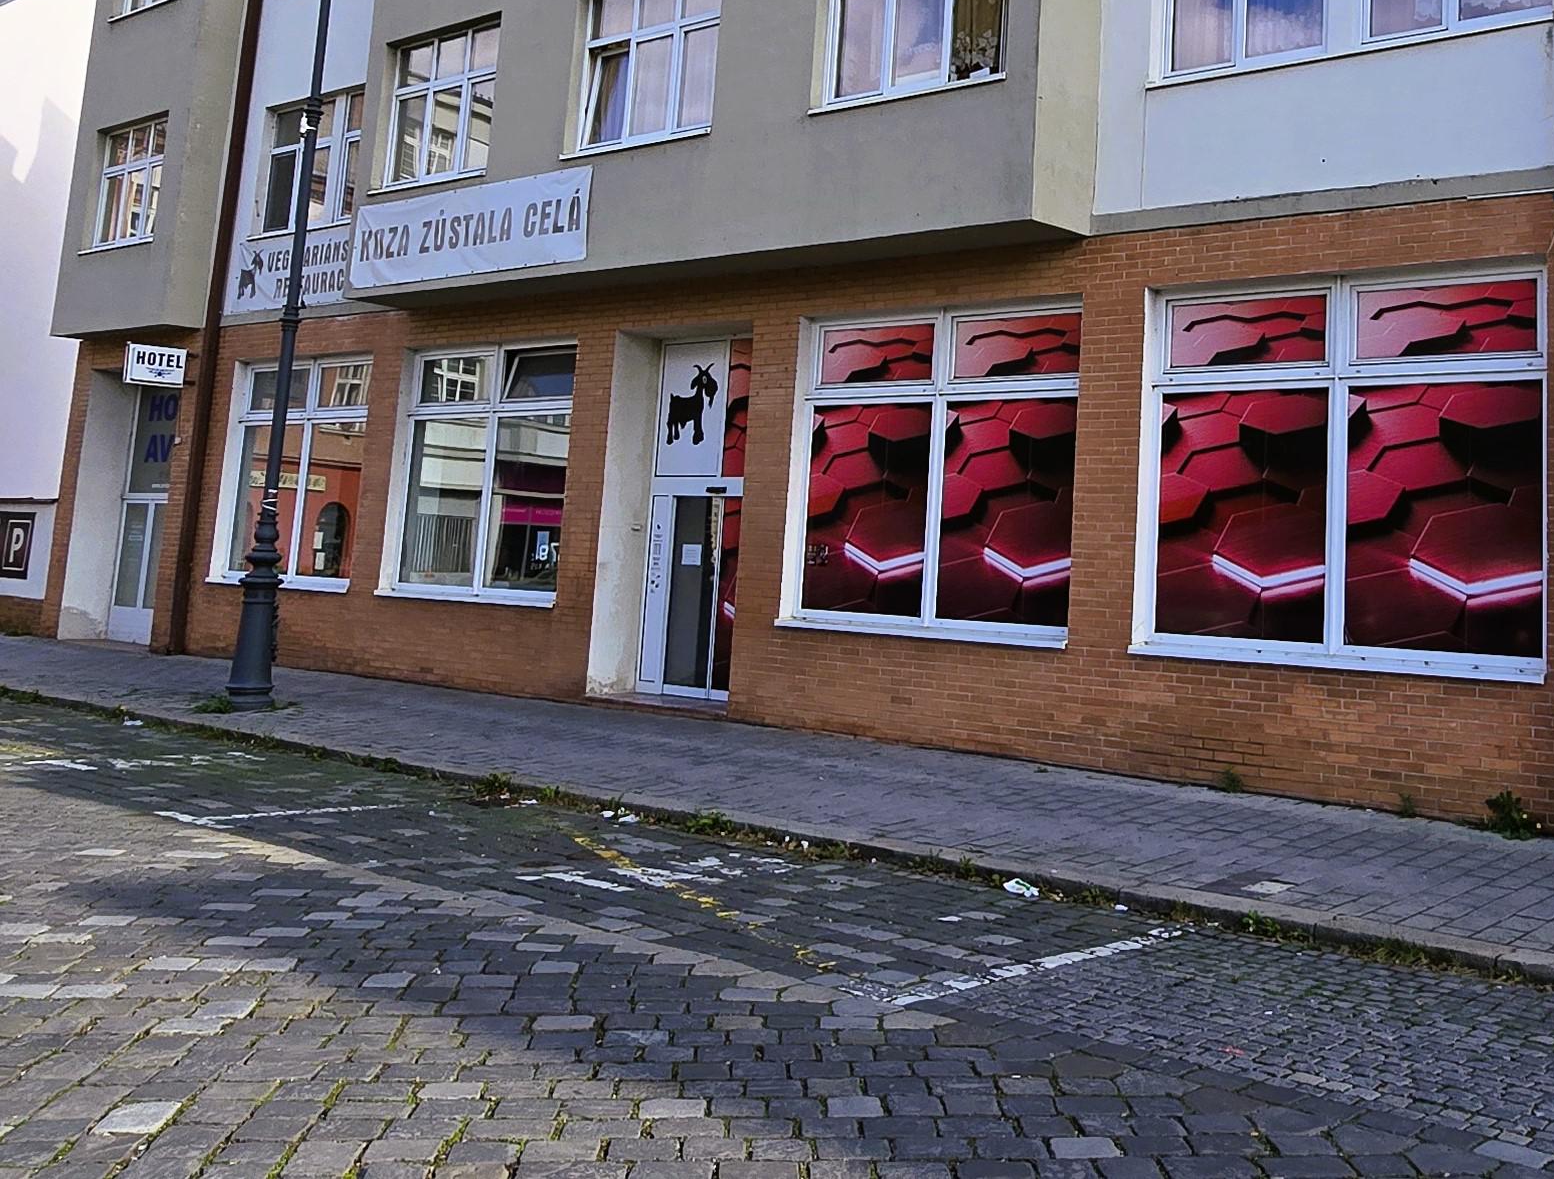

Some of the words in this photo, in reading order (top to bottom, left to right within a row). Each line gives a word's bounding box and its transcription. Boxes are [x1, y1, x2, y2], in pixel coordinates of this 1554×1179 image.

[359, 224, 411, 263] KOZA
[523, 188, 582, 239] CELÁ
[267, 238, 350, 273] VEGARIÁNS
[136, 350, 184, 369] HOTEL
[8, 527, 25, 563] P
